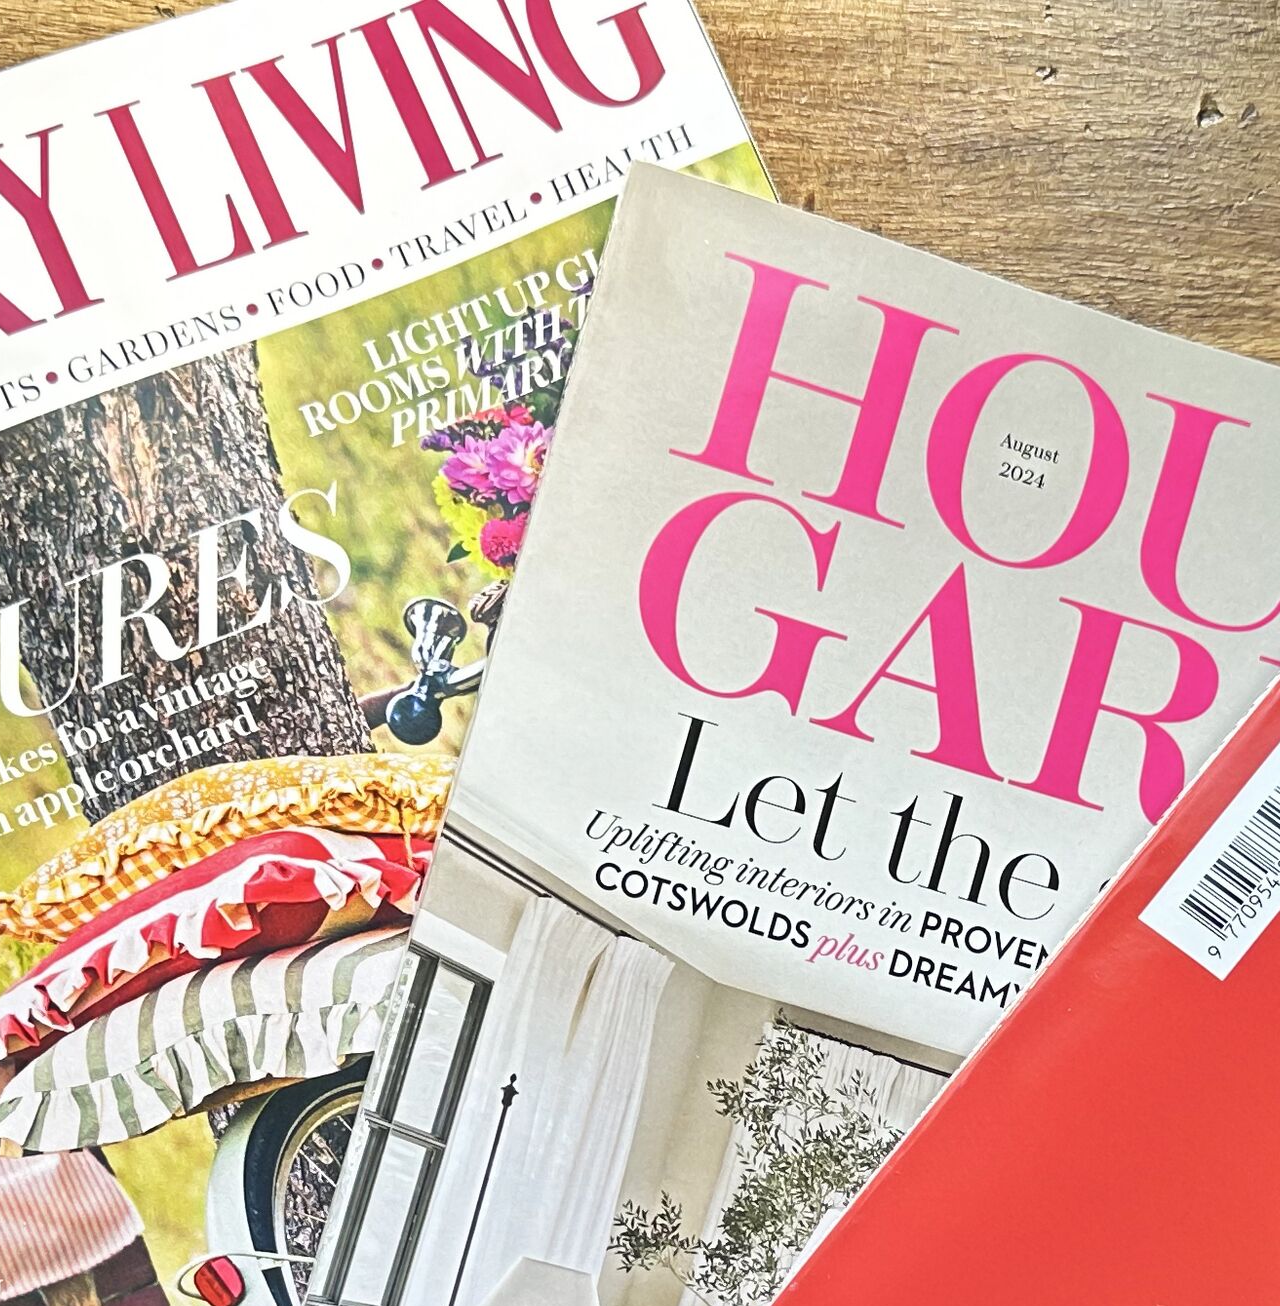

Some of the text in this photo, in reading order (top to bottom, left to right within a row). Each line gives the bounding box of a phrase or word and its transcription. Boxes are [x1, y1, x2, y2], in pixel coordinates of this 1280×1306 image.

[94, 0, 666, 281] LIVING
[67, 304, 244, 386] GARDENS
[265, 261, 368, 316] FOOD
[387, 199, 529, 271] TRAVEL
[362, 293, 493, 374] LIGHT
[492, 271, 551, 318] UP
[298, 354, 451, 438] ROOMS
[454, 303, 564, 381] WITH
[391, 341, 573, 448] PRIMARY
[998, 460, 1048, 490] 2024
[999, 429, 1061, 468] August
[16, 766, 117, 829] apple
[118, 700, 261, 784] orchard
[56, 717, 113, 758] for
[116, 708, 145, 735] a
[138, 656, 272, 722] vintage
[584, 808, 737, 886] Uplifting
[735, 856, 876, 923] interiors
[878, 901, 914, 935] in
[651, 710, 1062, 921] Let the
[594, 861, 1022, 1009] COTSWOLDS plus DREAM
